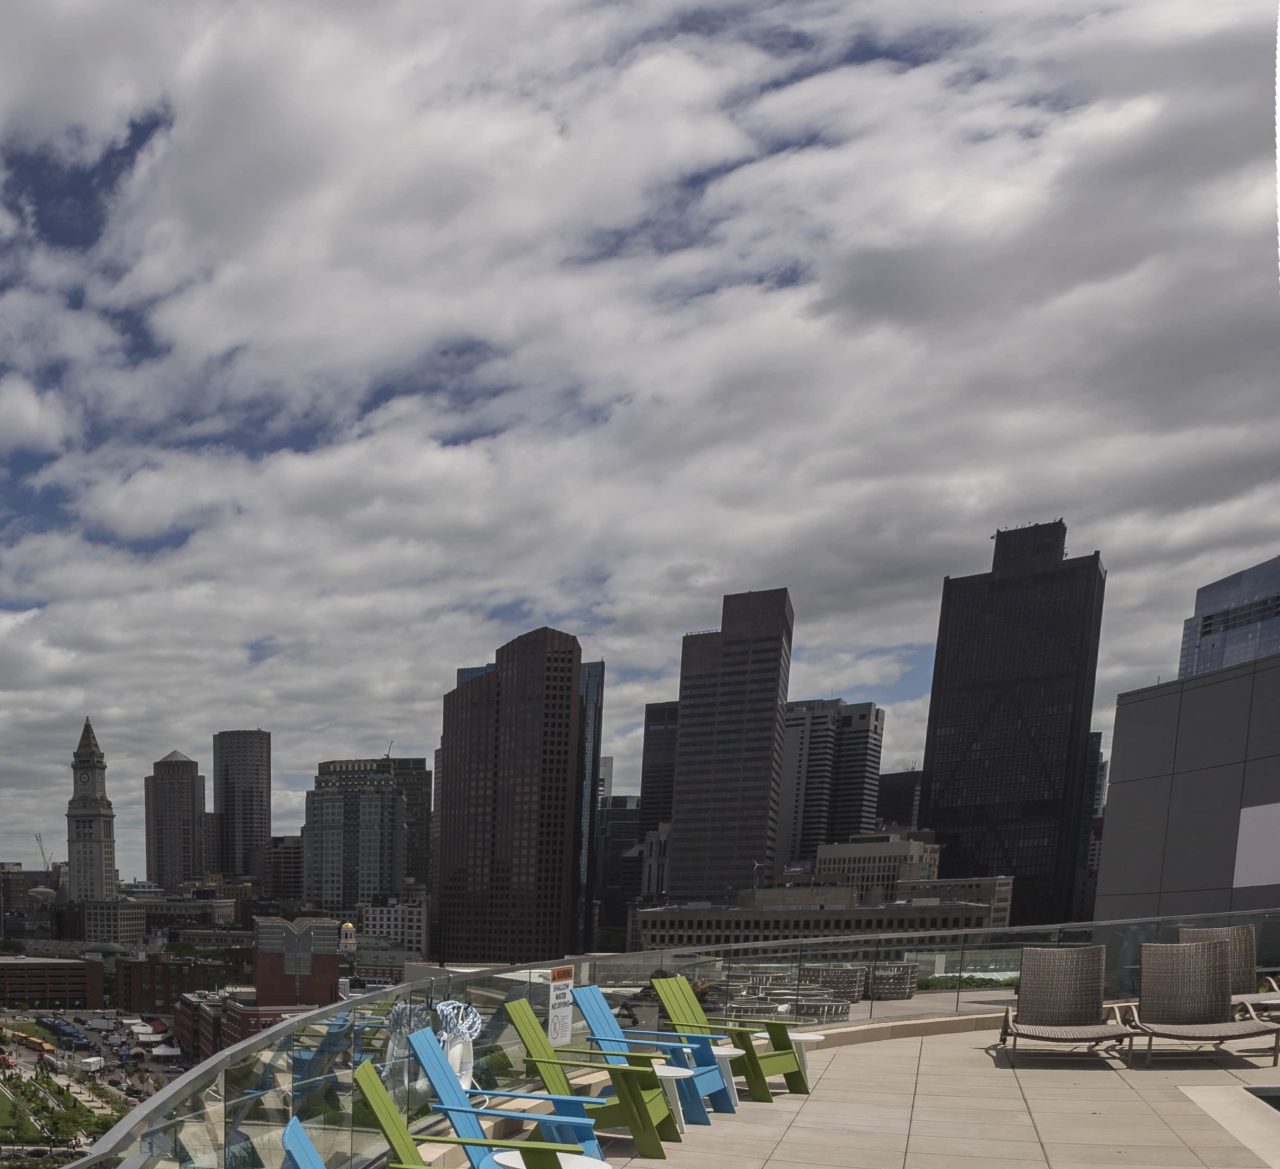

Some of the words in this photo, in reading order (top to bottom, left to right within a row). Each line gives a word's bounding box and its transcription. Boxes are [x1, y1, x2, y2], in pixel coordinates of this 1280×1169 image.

[553, 983, 569, 992] SHALLOW
[555, 992, 567, 1000] WATER
[552, 1002, 558, 1010] NO
[558, 1001, 569, 1009] DIVING
